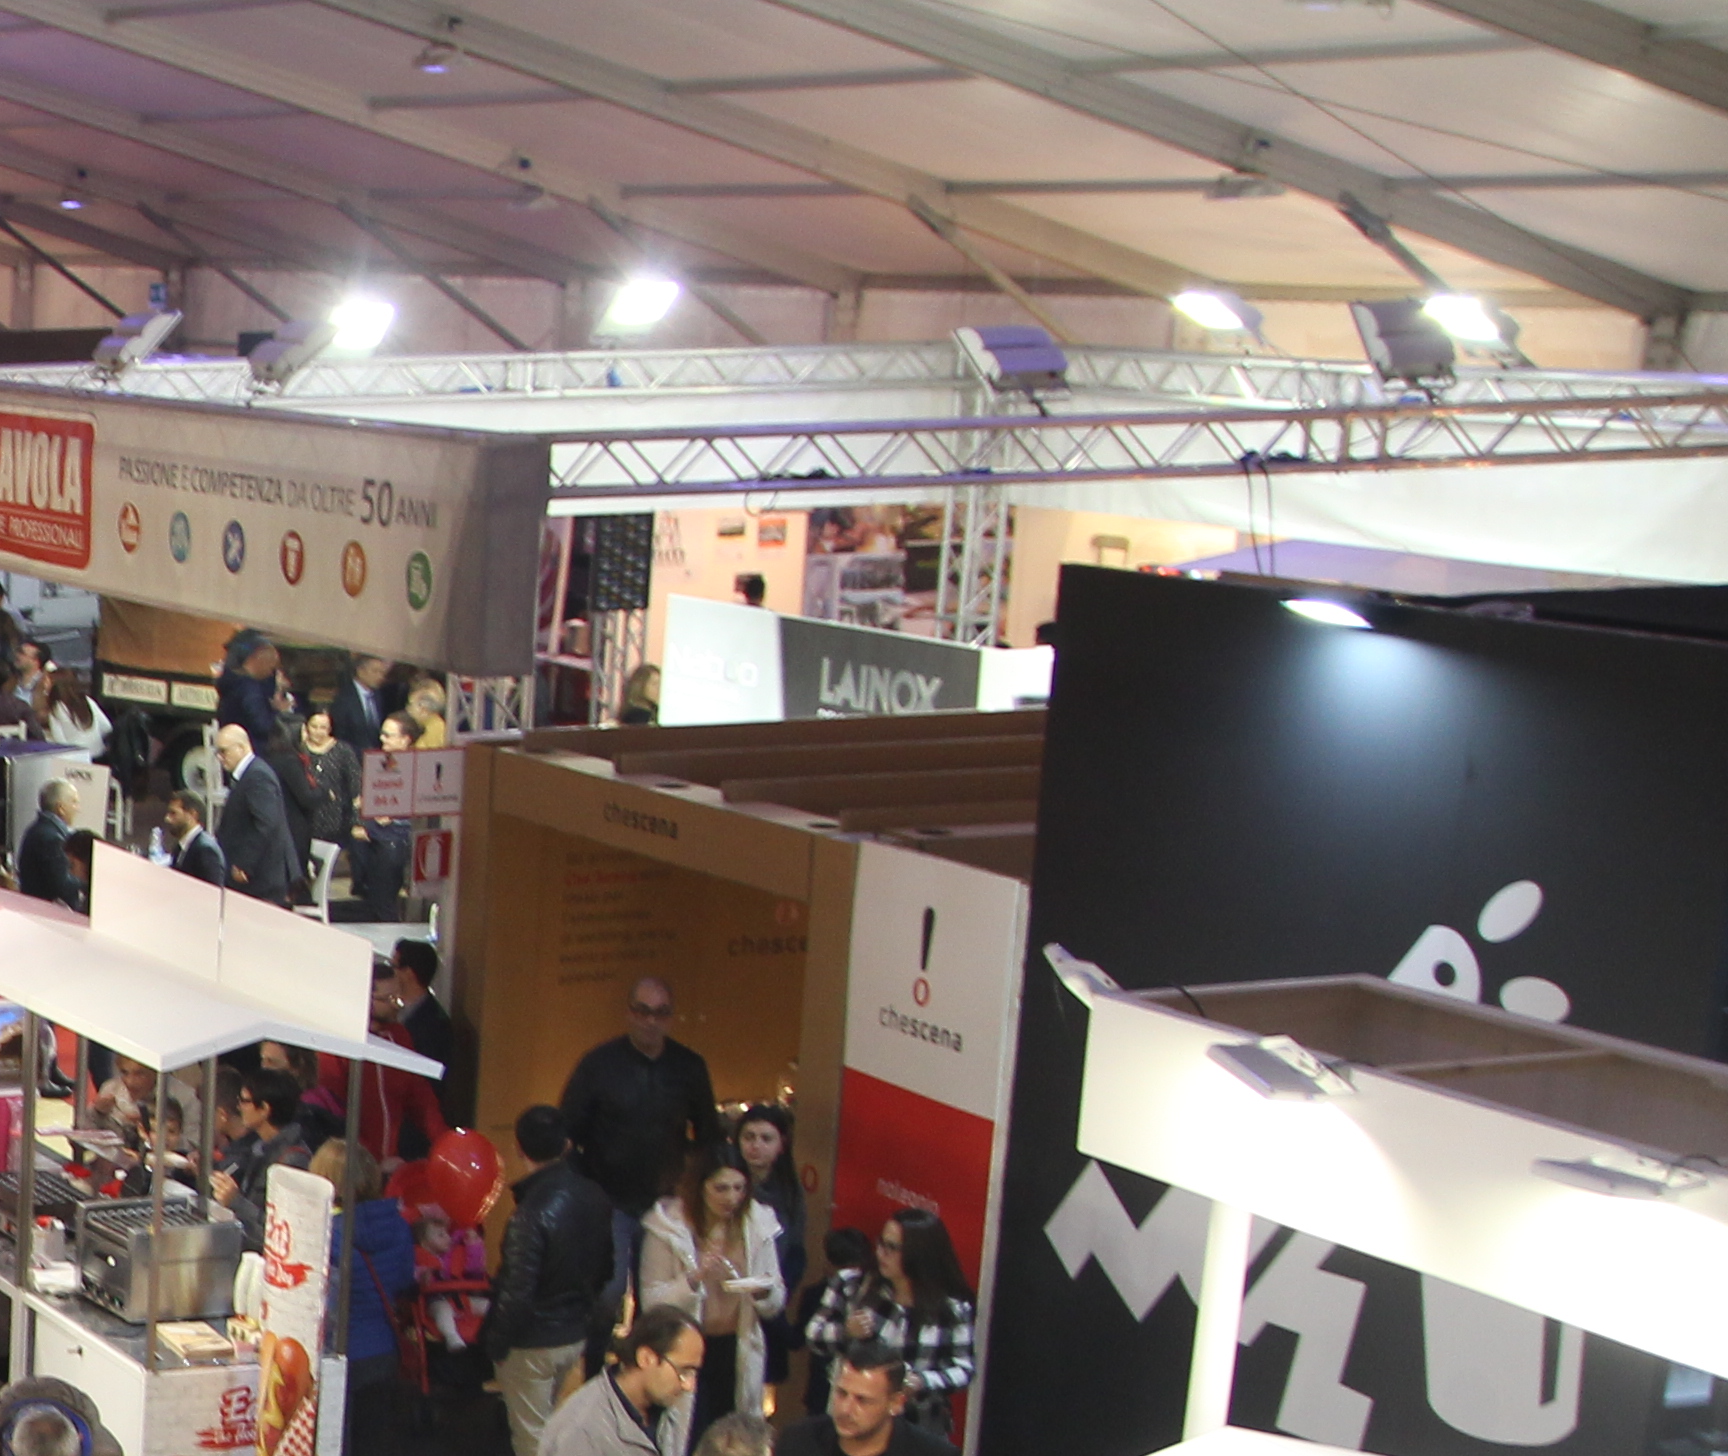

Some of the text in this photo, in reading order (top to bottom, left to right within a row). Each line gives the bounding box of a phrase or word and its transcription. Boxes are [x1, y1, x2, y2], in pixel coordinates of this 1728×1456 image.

[118, 456, 178, 490] PASSIONE
[192, 466, 284, 506] COMPETENZA
[359, 476, 394, 528] 50
[818, 657, 943, 714] LAINOX
[879, 1003, 963, 1053] chescena
